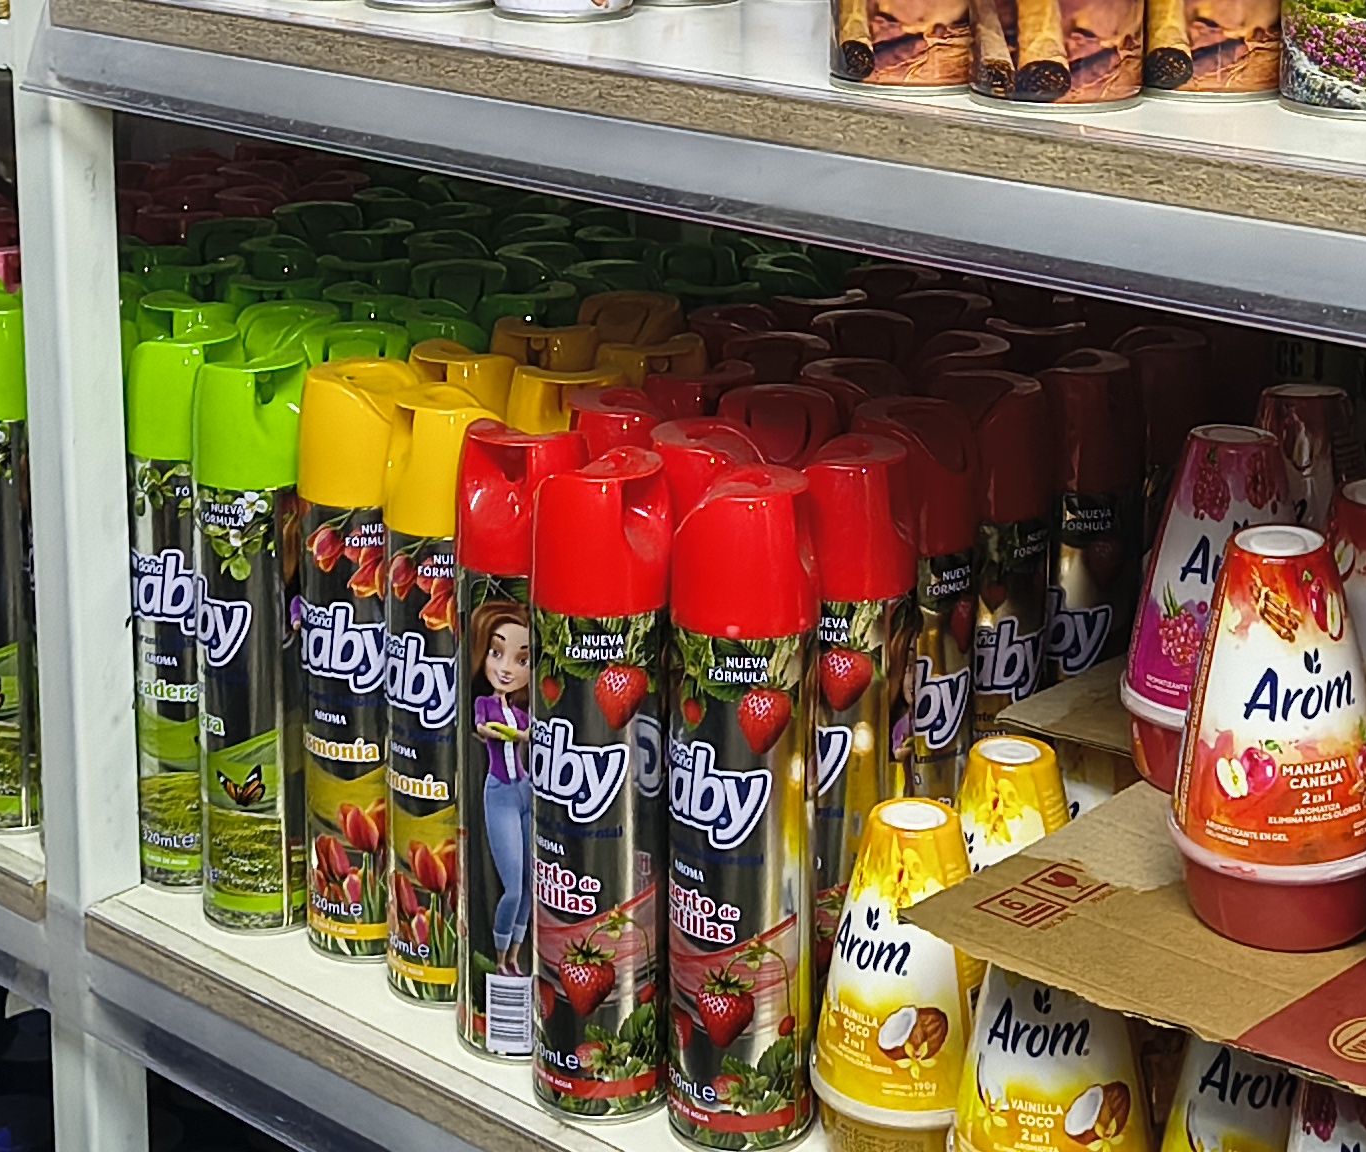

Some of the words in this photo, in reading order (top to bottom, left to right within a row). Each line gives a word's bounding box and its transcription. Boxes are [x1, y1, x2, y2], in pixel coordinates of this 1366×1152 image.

[725, 656, 769, 671] NUEVA
[708, 667, 769, 684] FÓRMULA
[1243, 667, 1354, 723] Arom
[304, 732, 380, 762] rmonía
[532, 717, 629, 823] aby
[1281, 757, 1347, 777] MANZANA
[1289, 774, 1343, 790] CANELA
[669, 740, 772, 849] aby
[1301, 792, 1311, 805] 2
[1312, 794, 1325, 803] EN
[1326, 789, 1332, 802] 1
[1268, 814, 1303, 825] ELIMINA
[669, 880, 715, 917] uerto
[718, 903, 741, 921] de
[835, 910, 911, 976] Arom
[988, 997, 1090, 1058] Arom
[1010, 1097, 1064, 1116] VAINILLA
[1018, 1114, 1055, 1129] COCO
